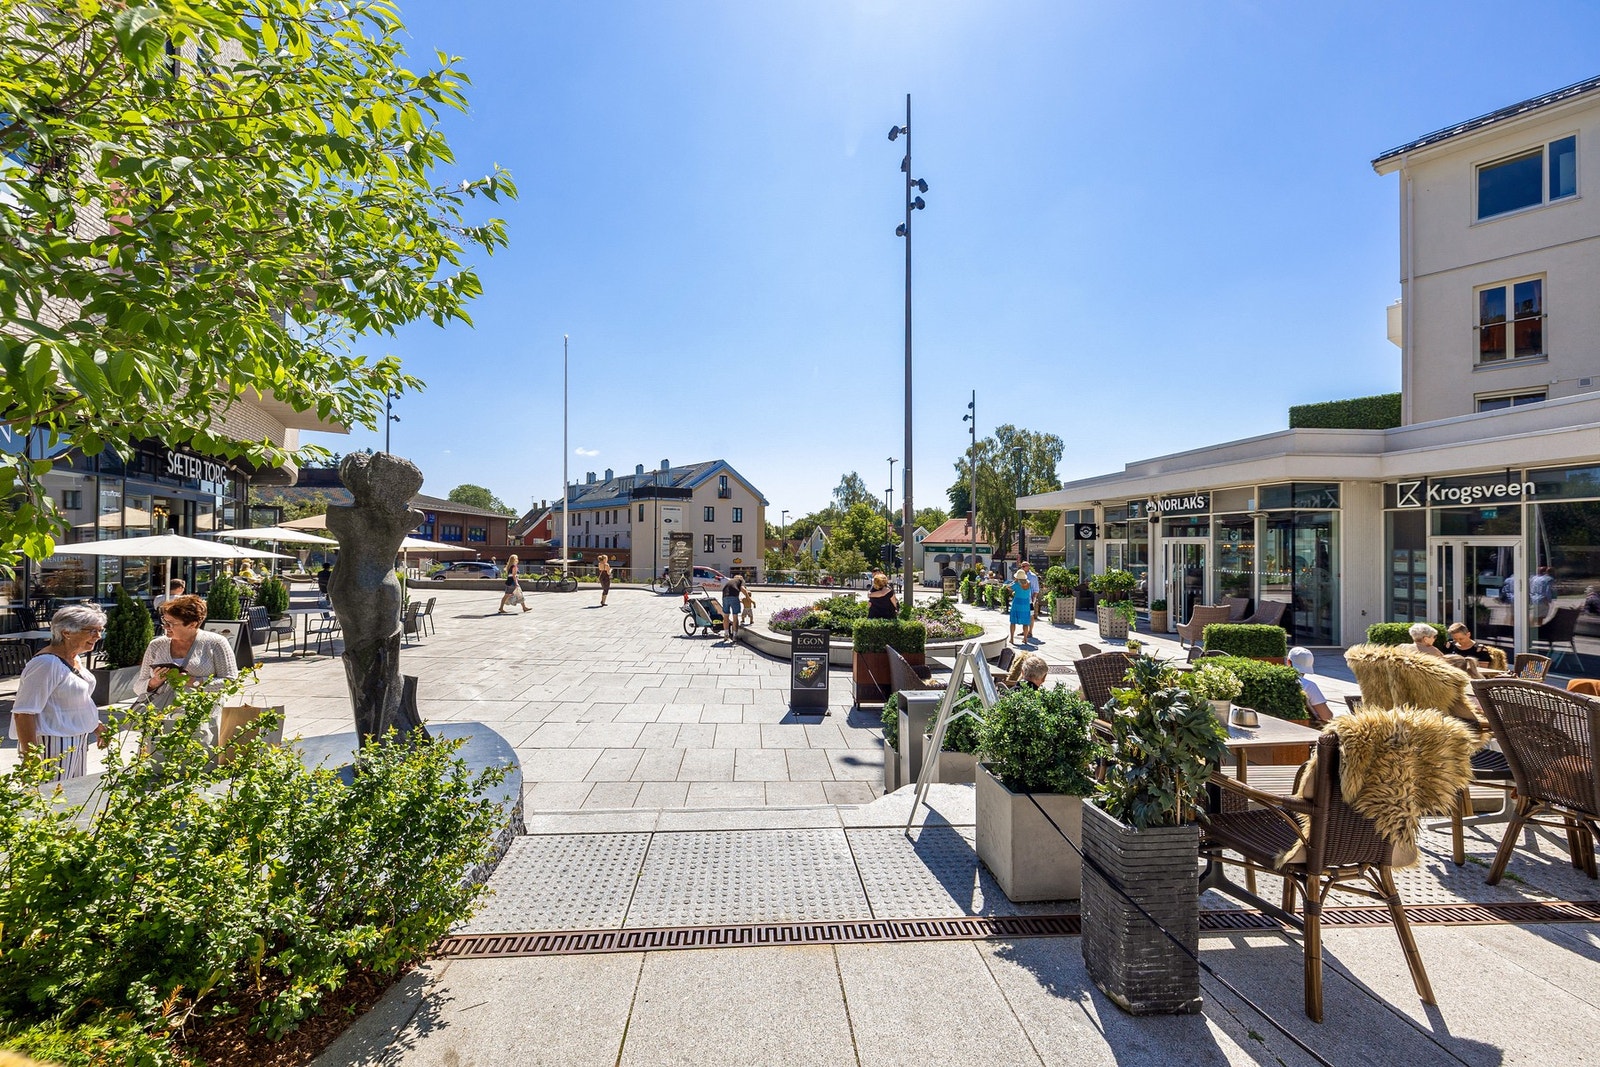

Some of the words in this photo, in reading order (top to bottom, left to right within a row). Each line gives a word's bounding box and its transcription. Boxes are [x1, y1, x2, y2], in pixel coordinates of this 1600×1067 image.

[167, 450, 202, 480] SÆTER
[203, 460, 227, 485] TORG
[1427, 481, 1535, 505] Krogsveen
[1157, 496, 1205, 511] NORLAKS
[797, 637, 824, 645] EGON
